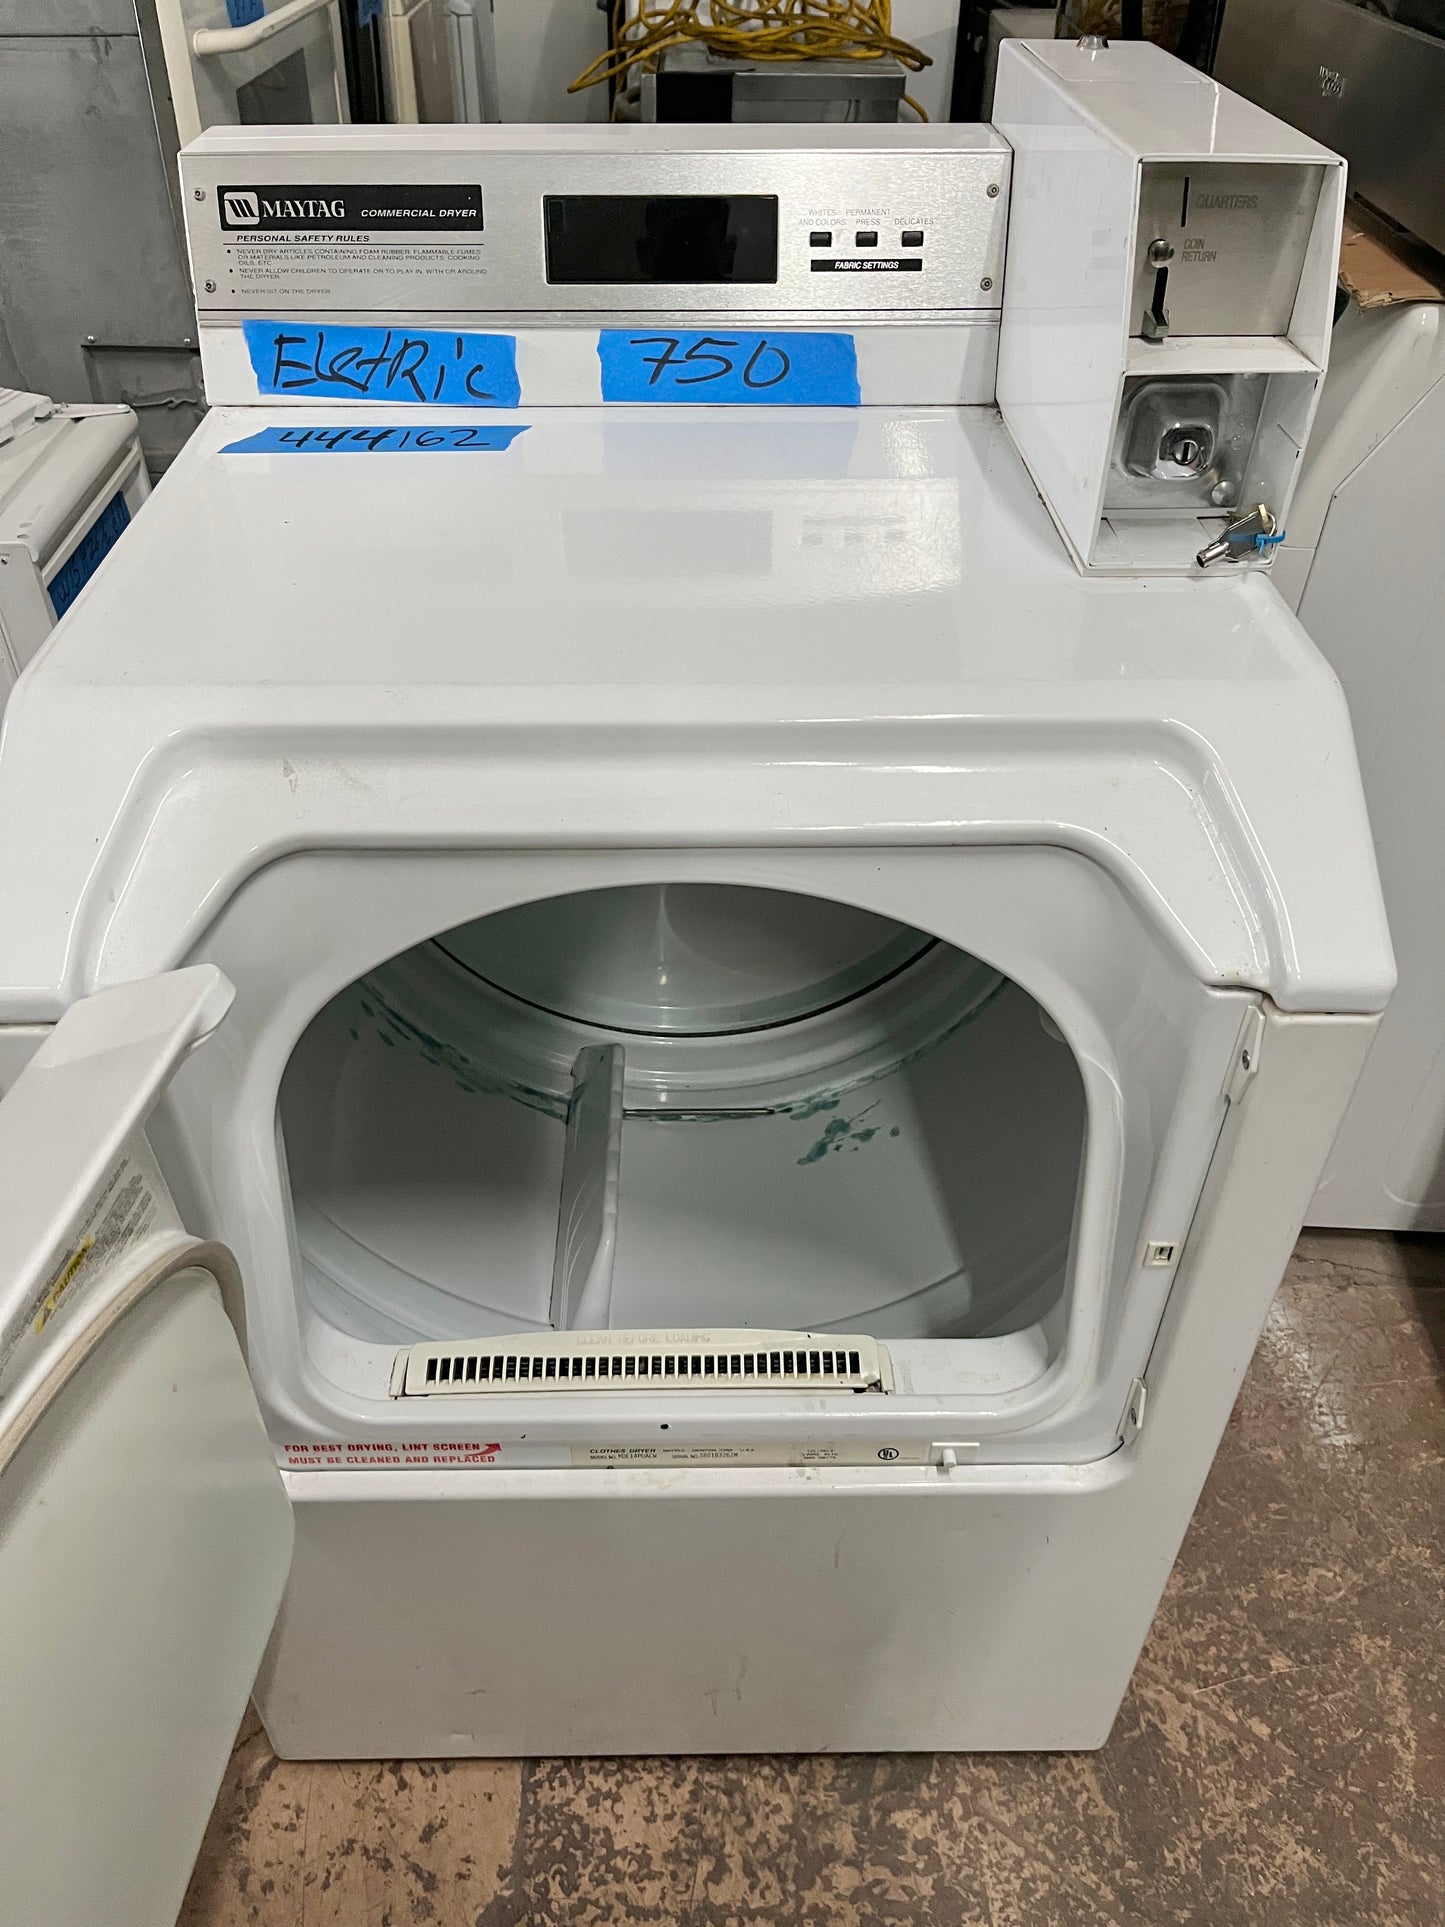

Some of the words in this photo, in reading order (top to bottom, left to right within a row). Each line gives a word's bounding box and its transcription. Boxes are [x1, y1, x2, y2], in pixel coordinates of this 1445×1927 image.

[1196, 194, 1258, 210] QUARTERS
[261, 199, 345, 218] MAYTAG
[361, 209, 436, 217] COMMERCIAL
[438, 209, 477, 217] DRYER
[808, 208, 837, 216] WHITES
[845, 208, 891, 216] PERMANENT
[799, 218, 814, 226] AND
[815, 218, 847, 226] COLORS
[855, 218, 881, 226] PRESS
[894, 217, 934, 226] DELICATES
[236, 235, 292, 243] PERSONAL
[294, 235, 334, 243] SAFETY
[335, 235, 370, 243] RULES
[1184, 238, 1206, 250] COIN
[1181, 250, 1217, 263] RETURN
[834, 261, 862, 269] FABRIC
[862, 261, 900, 269] SETTINGS
[630, 337, 790, 388] 750
[278, 429, 490, 450] 444162
[576, 1334, 612, 1345] CLEAN
[665, 1332, 711, 1343] LOADING
[284, 1444, 309, 1452] FOR
[313, 1444, 343, 1452] BEST
[347, 1443, 398, 1452] DRYING,
[402, 1443, 429, 1451] LINT
[433, 1442, 480, 1451] SCREEN
[288, 1456, 322, 1464] MUST
[326, 1456, 342, 1464] BE
[347, 1456, 400, 1464] CLEANED
[405, 1455, 429, 1463] AND
[433, 1455, 495, 1463] REPLACED
